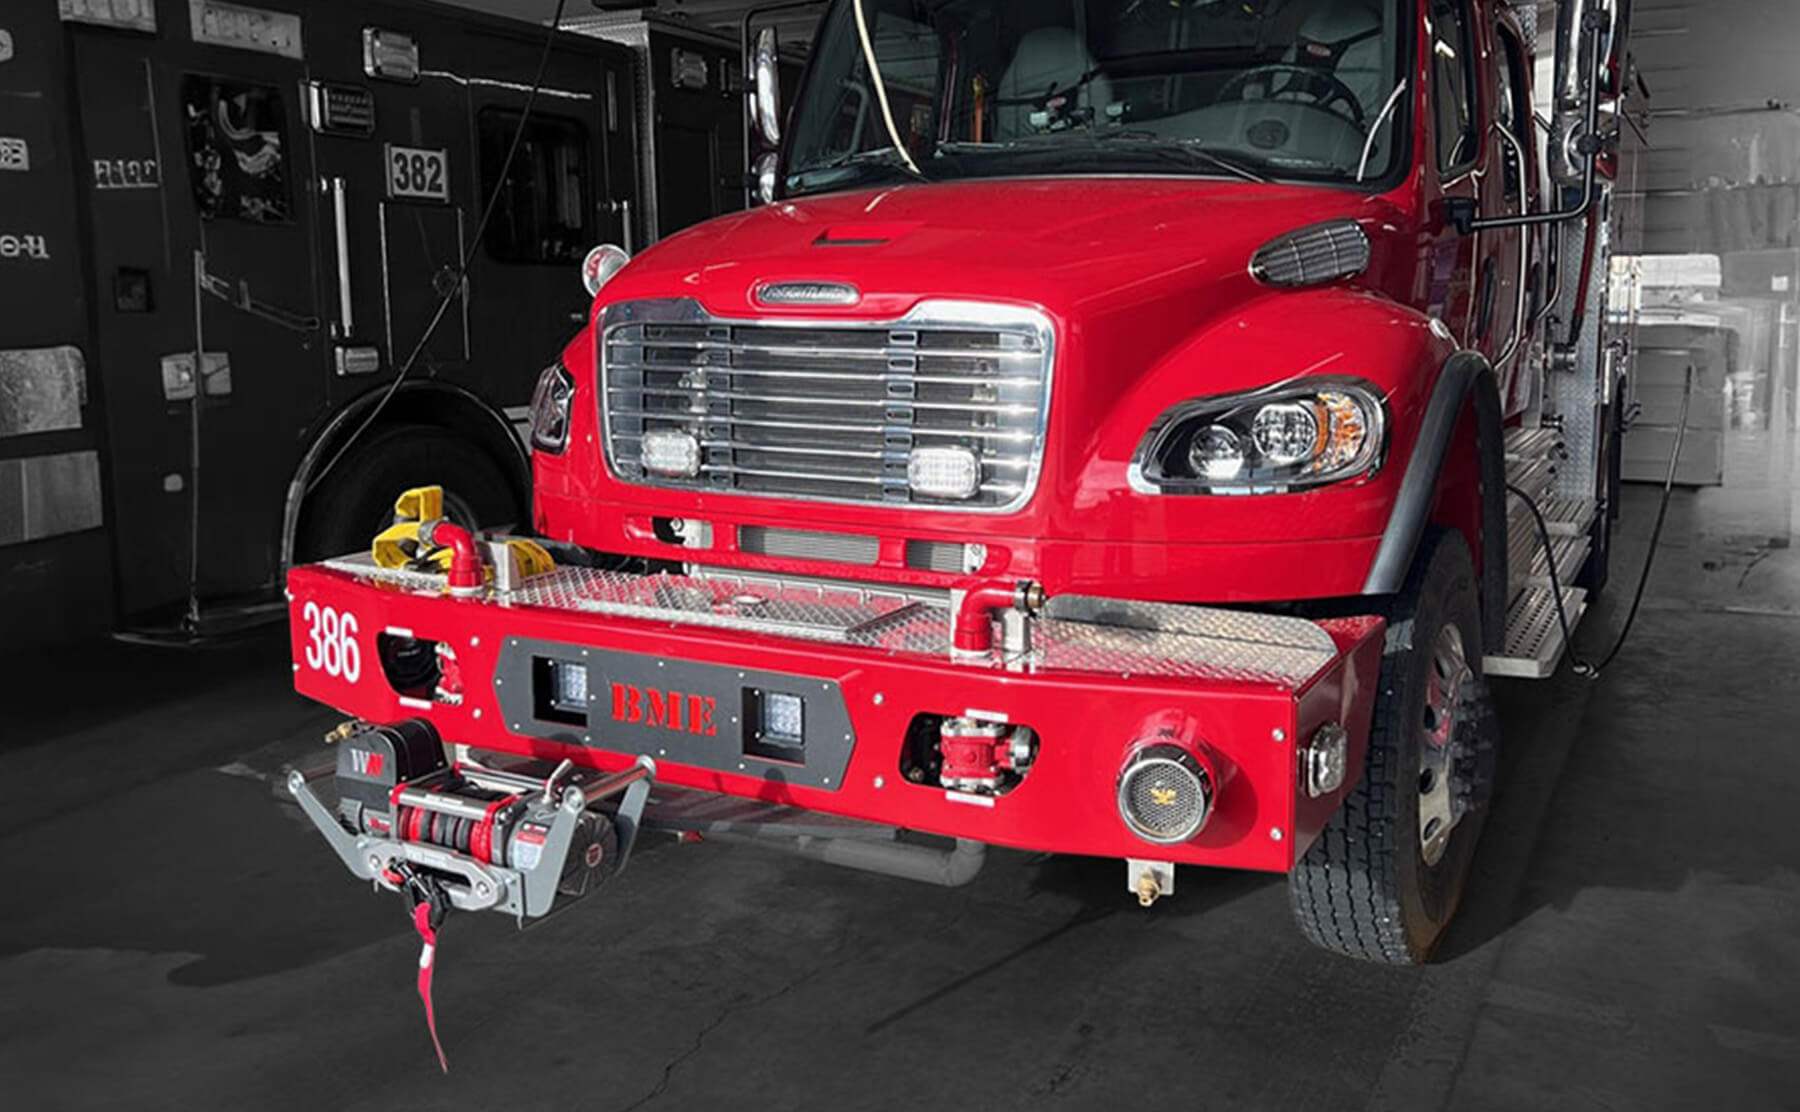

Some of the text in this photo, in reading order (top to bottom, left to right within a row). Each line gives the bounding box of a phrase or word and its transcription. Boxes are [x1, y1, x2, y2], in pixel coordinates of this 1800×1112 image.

[394, 152, 442, 193] 382
[303, 601, 361, 684] 386
[611, 682, 717, 737] BME
